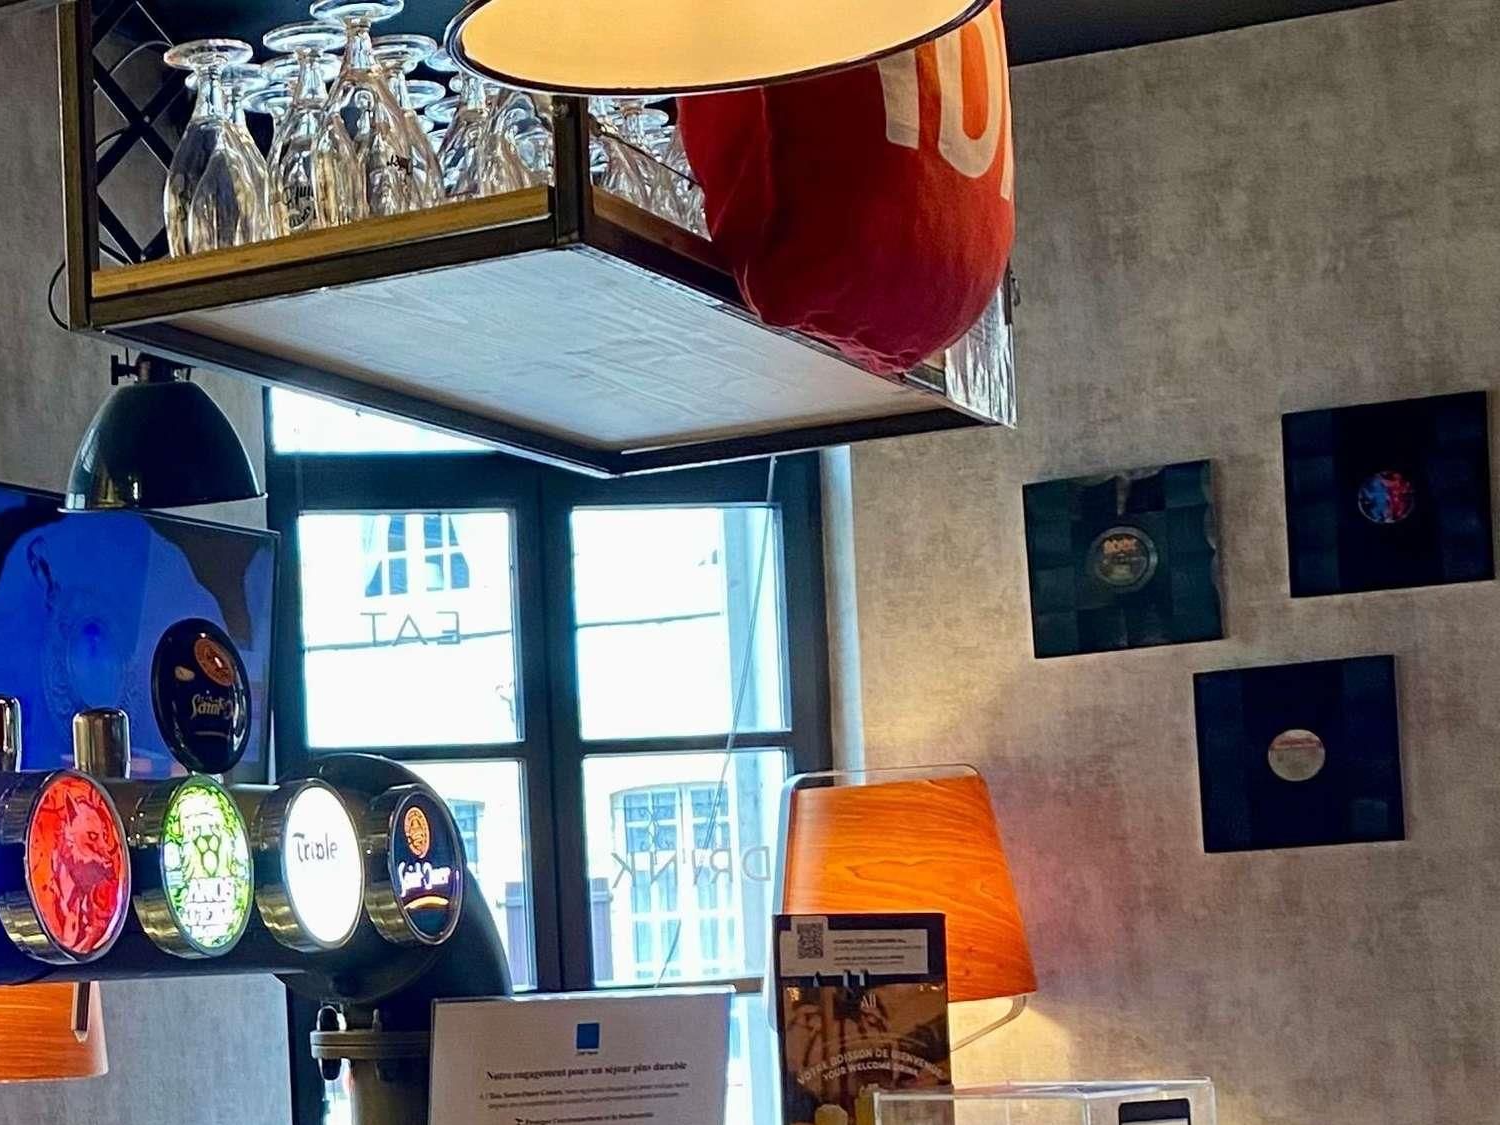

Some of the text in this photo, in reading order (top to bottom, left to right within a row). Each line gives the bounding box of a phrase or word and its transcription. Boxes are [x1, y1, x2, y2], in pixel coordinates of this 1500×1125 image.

[292, 832, 339, 863] Triple
[875, 1048, 890, 1059] DE
[567, 1068, 588, 1079] pour
[822, 1066, 848, 1081] YOUR
[850, 1061, 891, 1073] WELCOME
